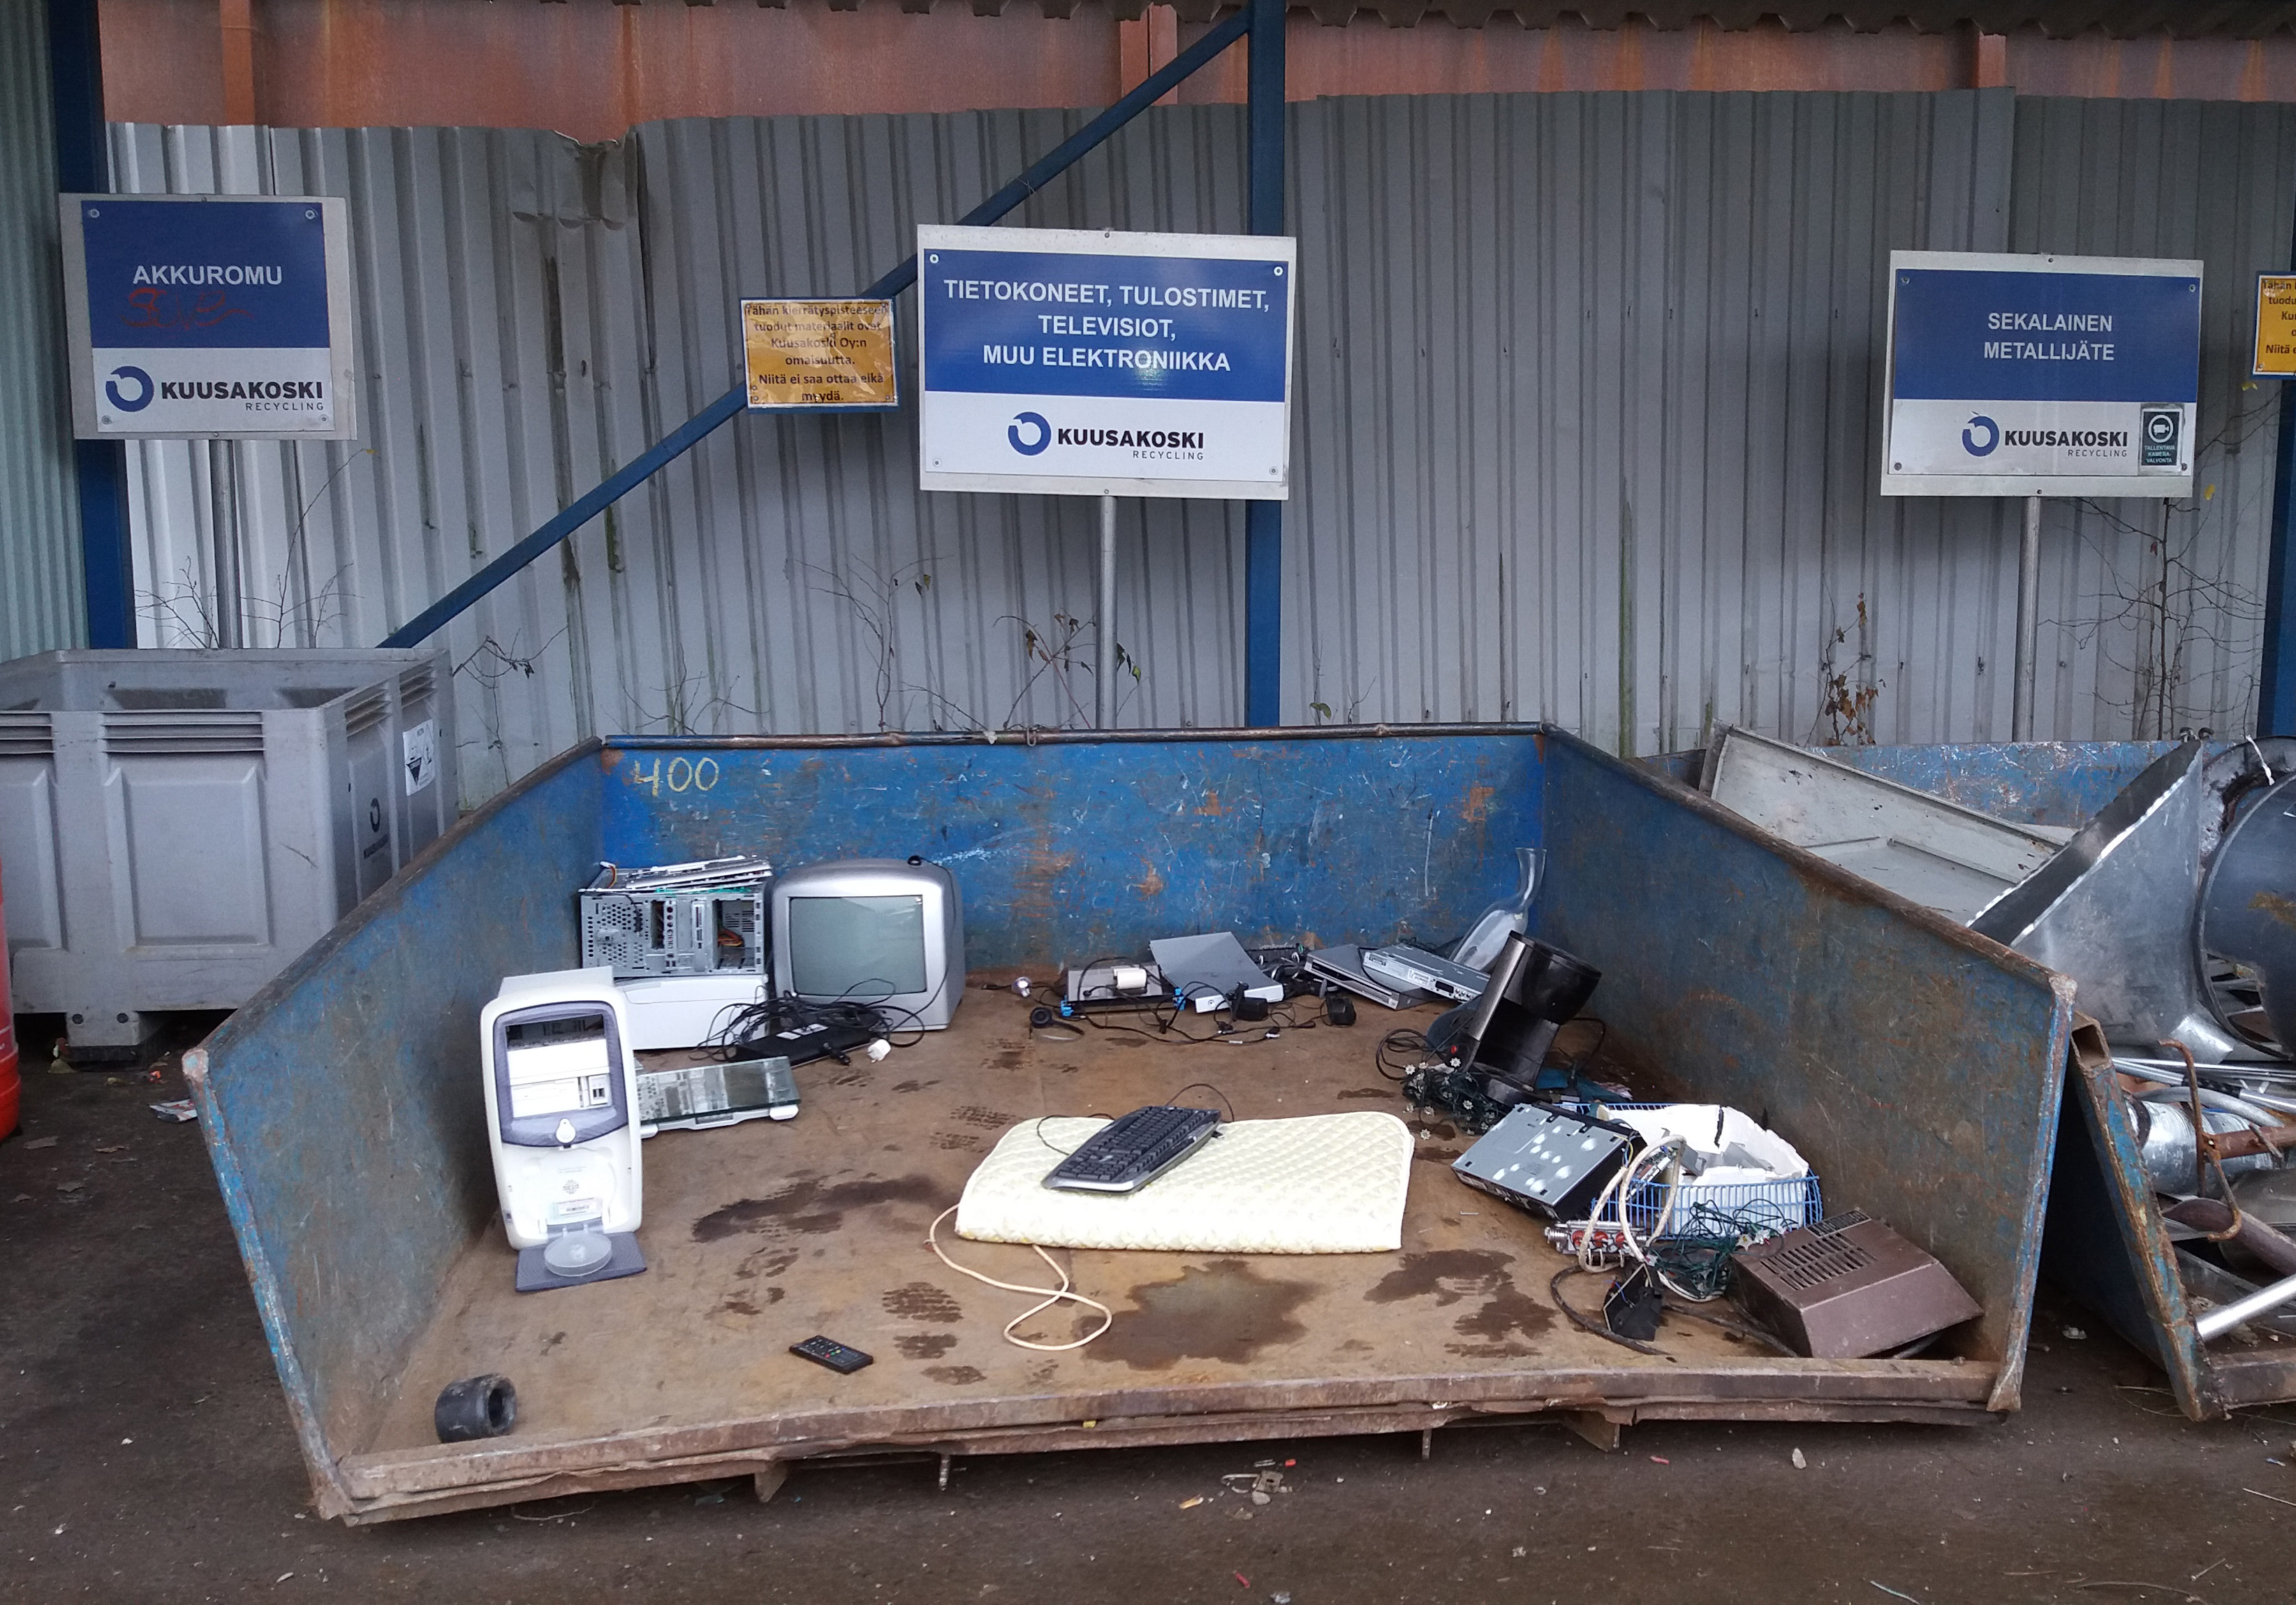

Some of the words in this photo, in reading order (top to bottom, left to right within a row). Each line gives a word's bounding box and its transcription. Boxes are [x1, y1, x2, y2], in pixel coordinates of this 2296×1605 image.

[132, 265, 282, 286] AKKUROMU
[944, 279, 1112, 307] TIETOKONEET,
[1119, 286, 1270, 313] TULOSTIMET,
[1038, 315, 1177, 341] TELEVISIOT,
[1987, 313, 2112, 332] SEKALAINEN
[771, 337, 836, 348] Kuusakoski
[840, 337, 867, 349] Oy:n
[1984, 340, 2114, 360] METALLIJÄTE
[785, 356, 855, 365] omaisuutta.
[983, 345, 1035, 365] MUU
[1043, 347, 1230, 372] ELEKTRONIIKKA
[759, 374, 786, 384] Niitä
[790, 374, 800, 384] ei
[804, 376, 823, 384] saa
[826, 375, 857, 383] ottaa
[161, 381, 323, 400] KUUSAKOSKI
[245, 402, 324, 411] RECYCLING
[1057, 428, 1205, 449] KUUSAKOSKI
[2004, 430, 2128, 447] KUUSAKOSKI
[1133, 450, 1205, 461] RECYCLING
[2068, 449, 2128, 457] RECYCLING
[634, 756, 720, 797] 400
